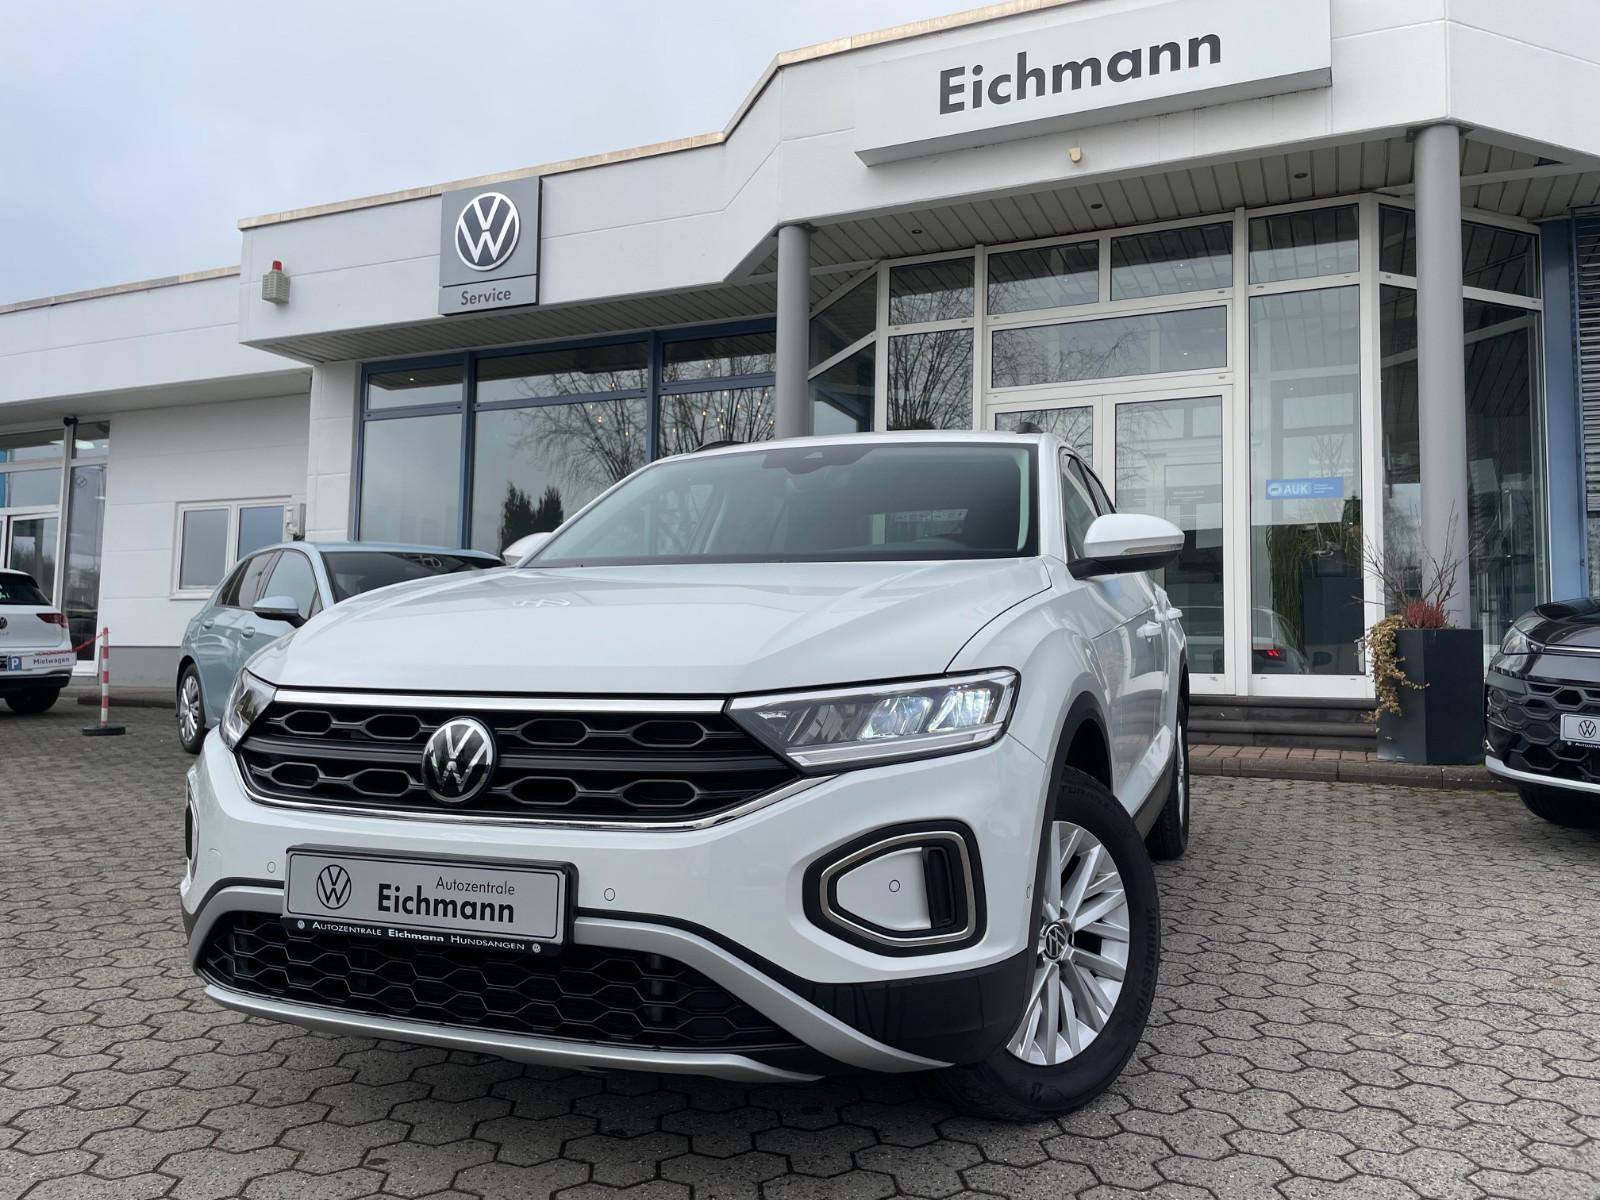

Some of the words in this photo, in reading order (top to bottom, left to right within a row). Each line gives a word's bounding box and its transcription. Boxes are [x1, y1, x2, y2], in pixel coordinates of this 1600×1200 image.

[939, 33, 1221, 115] Eichmann
[461, 288, 512, 305] Service
[1283, 483, 1308, 496] AUK
[33, 657, 70, 665] Mietwagen
[435, 876, 516, 896] Autozentrale
[377, 882, 515, 924] Eichmann
[312, 921, 382, 937] AUTOZENTRALE
[388, 929, 445, 943] Eichmann
[450, 935, 526, 951] HUNDSANGEN
